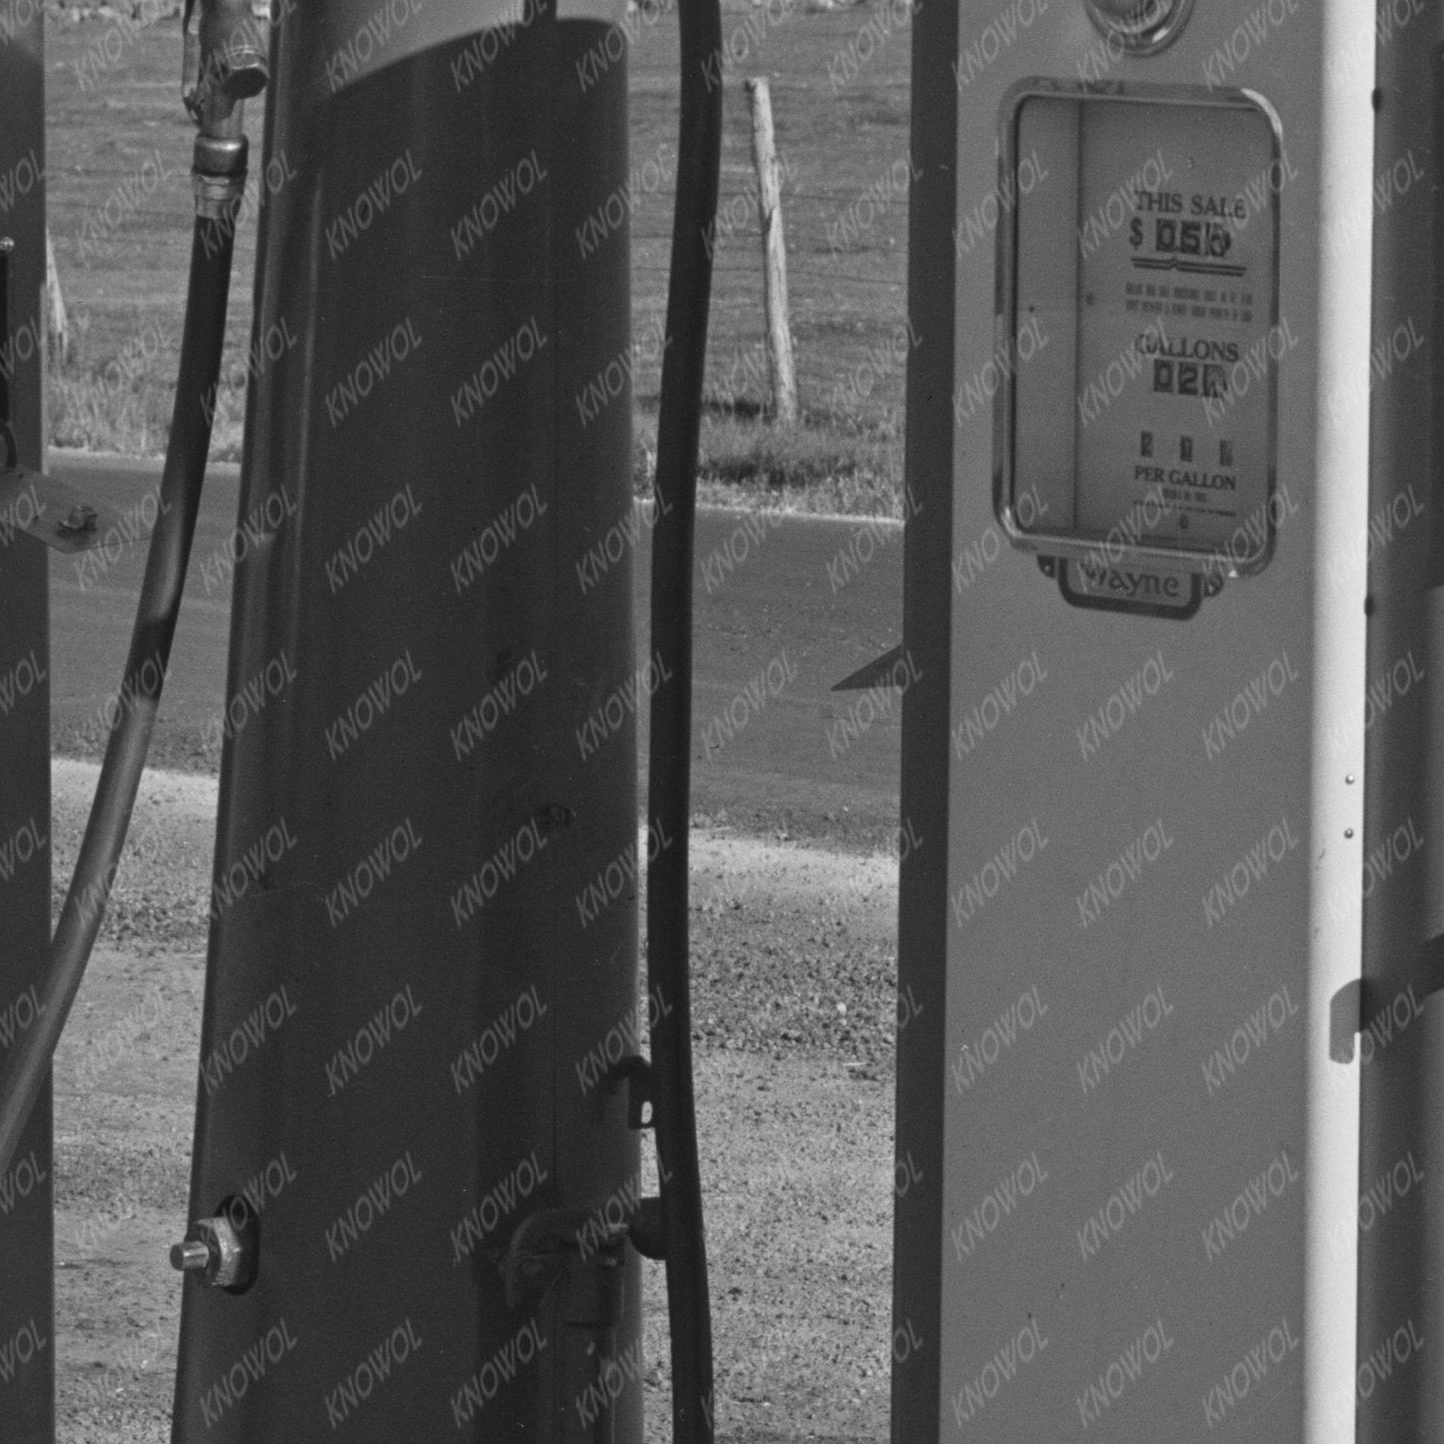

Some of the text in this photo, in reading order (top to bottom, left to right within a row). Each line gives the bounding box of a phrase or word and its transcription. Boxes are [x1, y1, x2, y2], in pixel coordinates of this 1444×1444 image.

[1134, 189, 1247, 220] THIS SALE
[1134, 331, 1239, 364] GALLONS
[1134, 465, 1237, 492] PER GALLON
